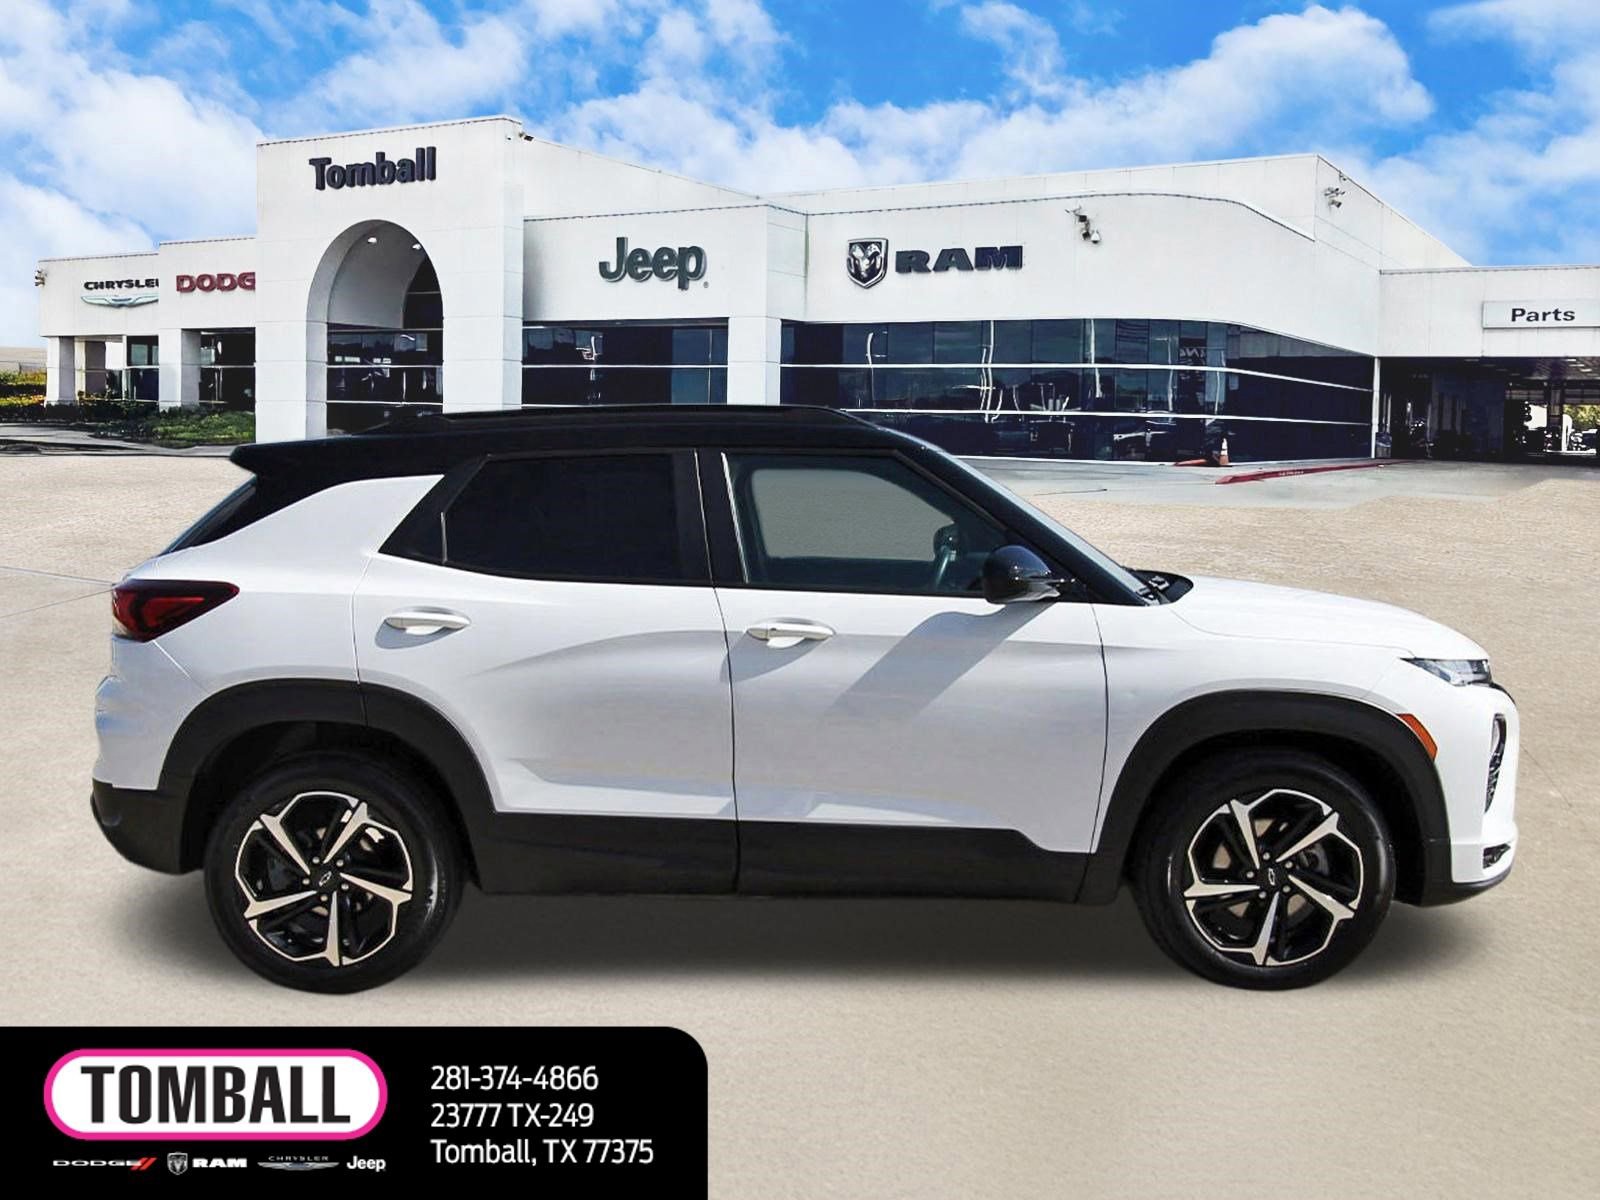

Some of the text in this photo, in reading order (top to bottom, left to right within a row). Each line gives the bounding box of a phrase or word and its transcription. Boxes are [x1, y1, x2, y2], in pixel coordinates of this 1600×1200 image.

[309, 147, 437, 190] Tomball
[599, 237, 707, 289] Jeep
[896, 245, 1023, 274] RAM
[176, 272, 255, 293] DODG
[1511, 307, 1576, 322] Parts
